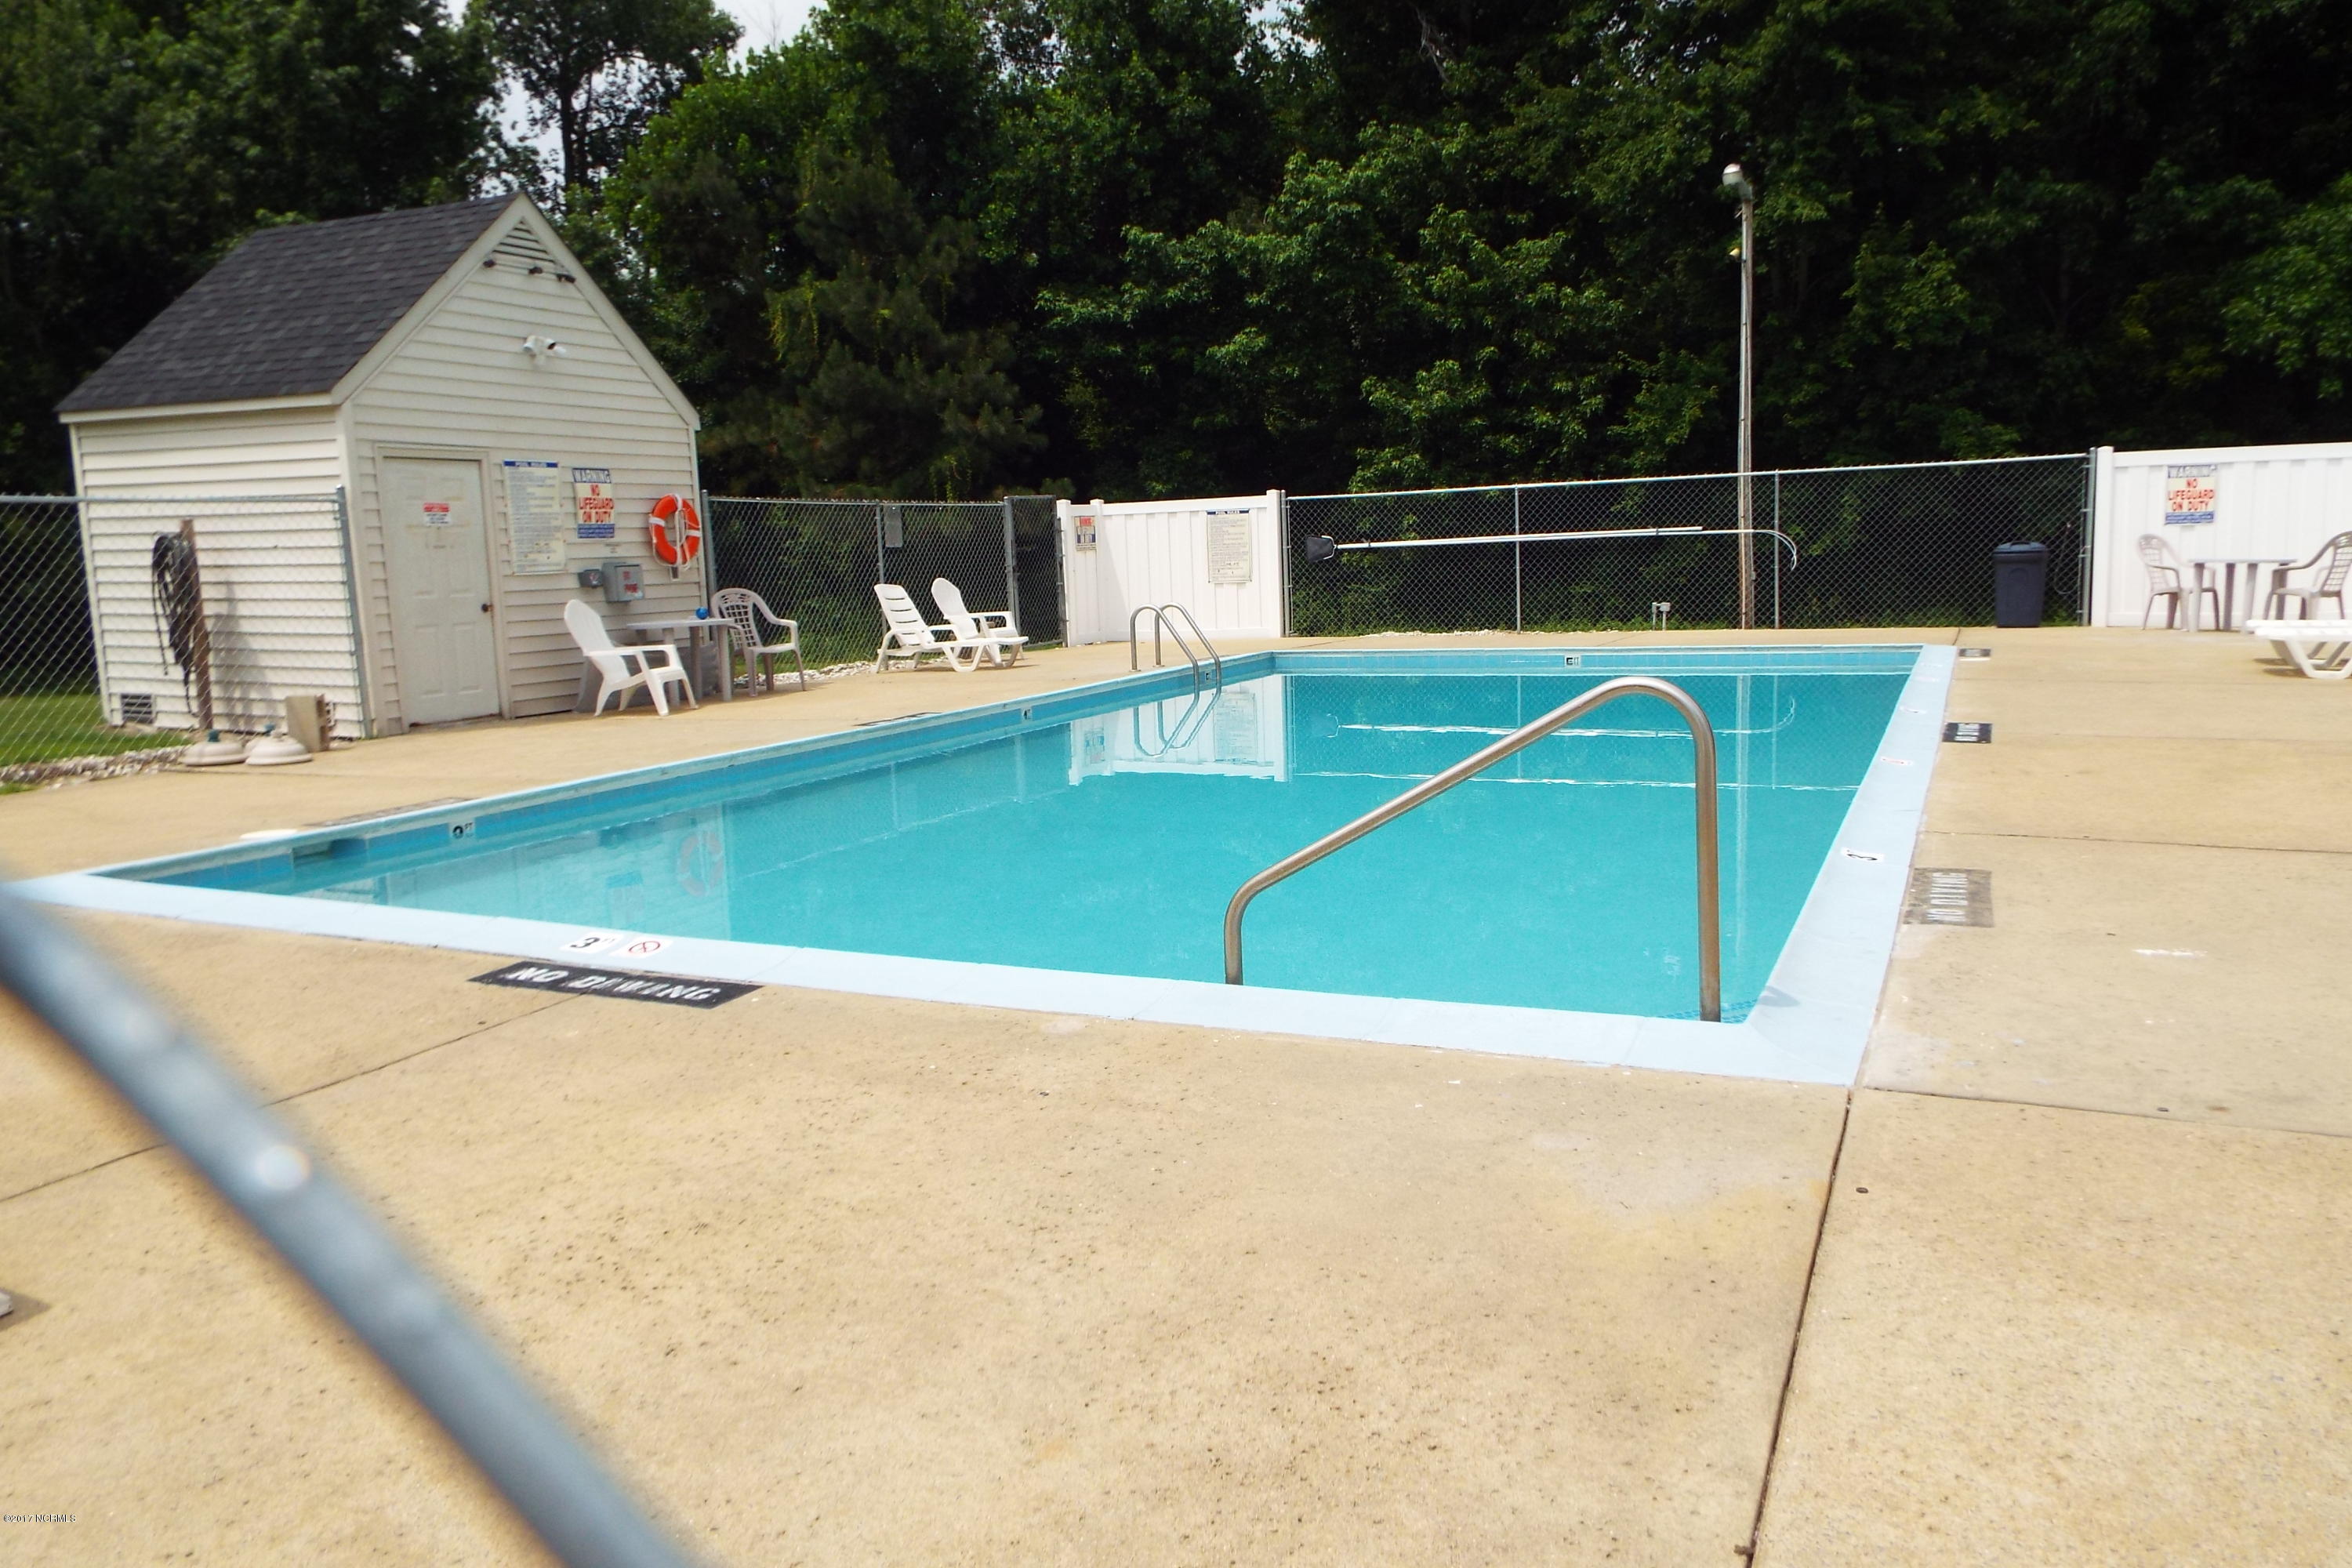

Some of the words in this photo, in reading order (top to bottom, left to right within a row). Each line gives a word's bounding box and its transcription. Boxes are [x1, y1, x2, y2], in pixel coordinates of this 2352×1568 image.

[573, 469, 611, 483] WARNING
[2187, 478, 2198, 488] NO
[590, 484, 601, 496] NO
[2168, 489, 2215, 501] LIFEGUARD
[579, 497, 614, 510] LIFEGUARD
[2172, 500, 2183, 511] ON
[2187, 500, 2209, 511] DUTY
[583, 510, 592, 523] ON
[595, 510, 612, 523] DUTY
[1929, 872, 1968, 906] DIVING
[570, 936, 601, 949] 3
[504, 966, 568, 983] NO
[564, 975, 721, 1000] DIVING
